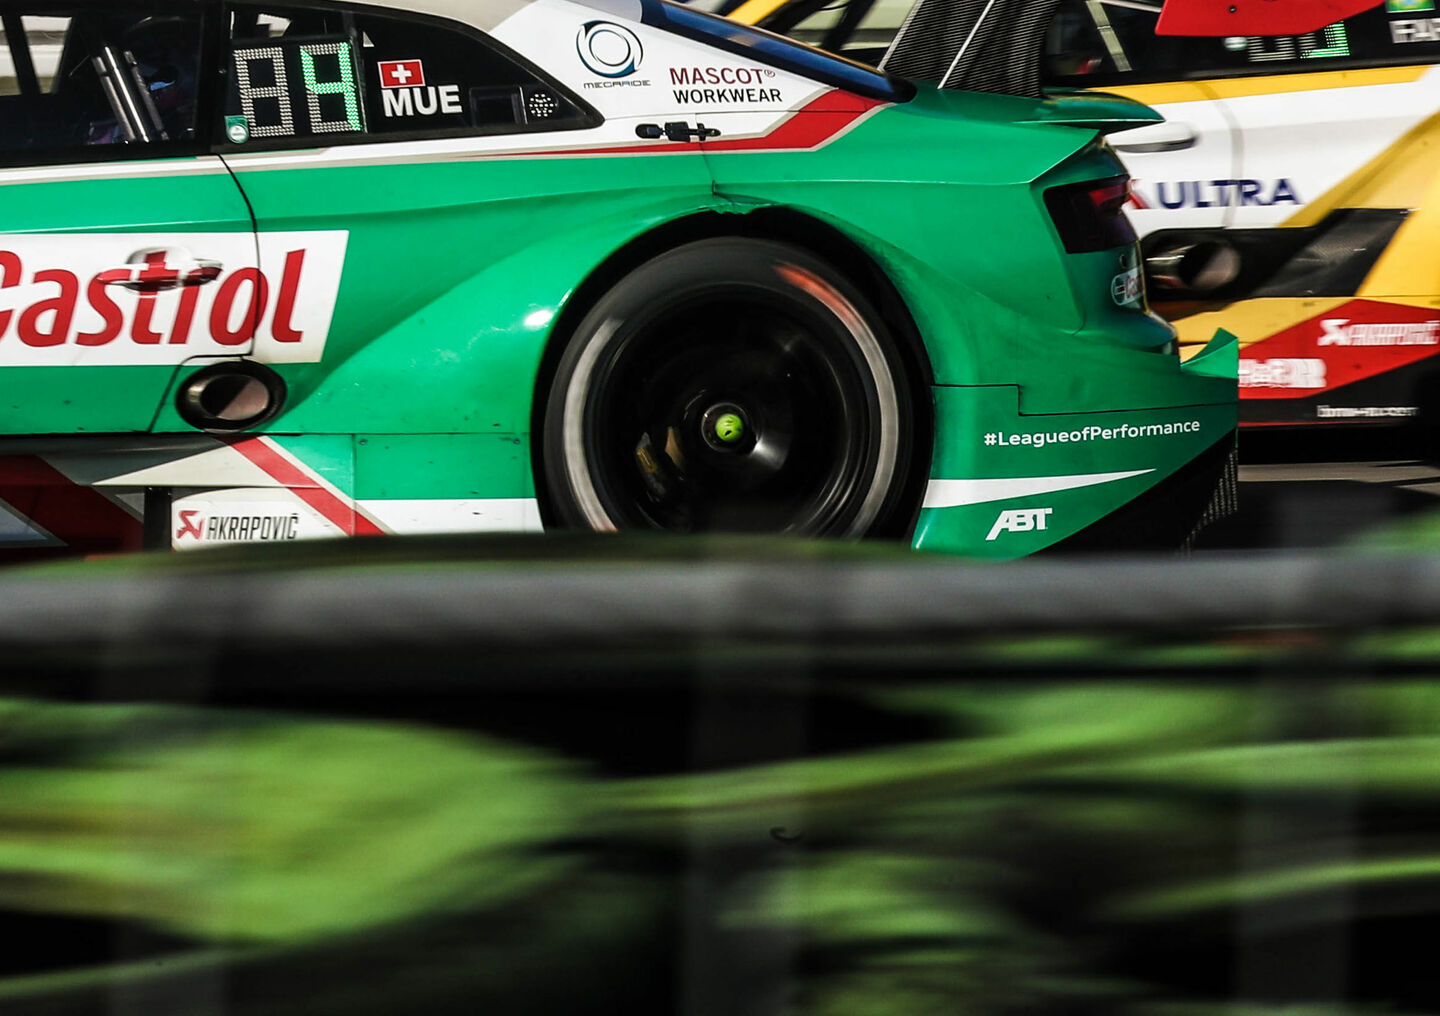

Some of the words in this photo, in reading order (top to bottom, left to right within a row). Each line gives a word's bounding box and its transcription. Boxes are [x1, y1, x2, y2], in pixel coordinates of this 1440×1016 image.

[381, 84, 463, 117] MUE
[672, 88, 784, 105] WORKWEAR
[1156, 178, 1304, 210] ULTRA
[984, 420, 1201, 448] #LeagueofPerformance
[985, 508, 1053, 541] ABT
